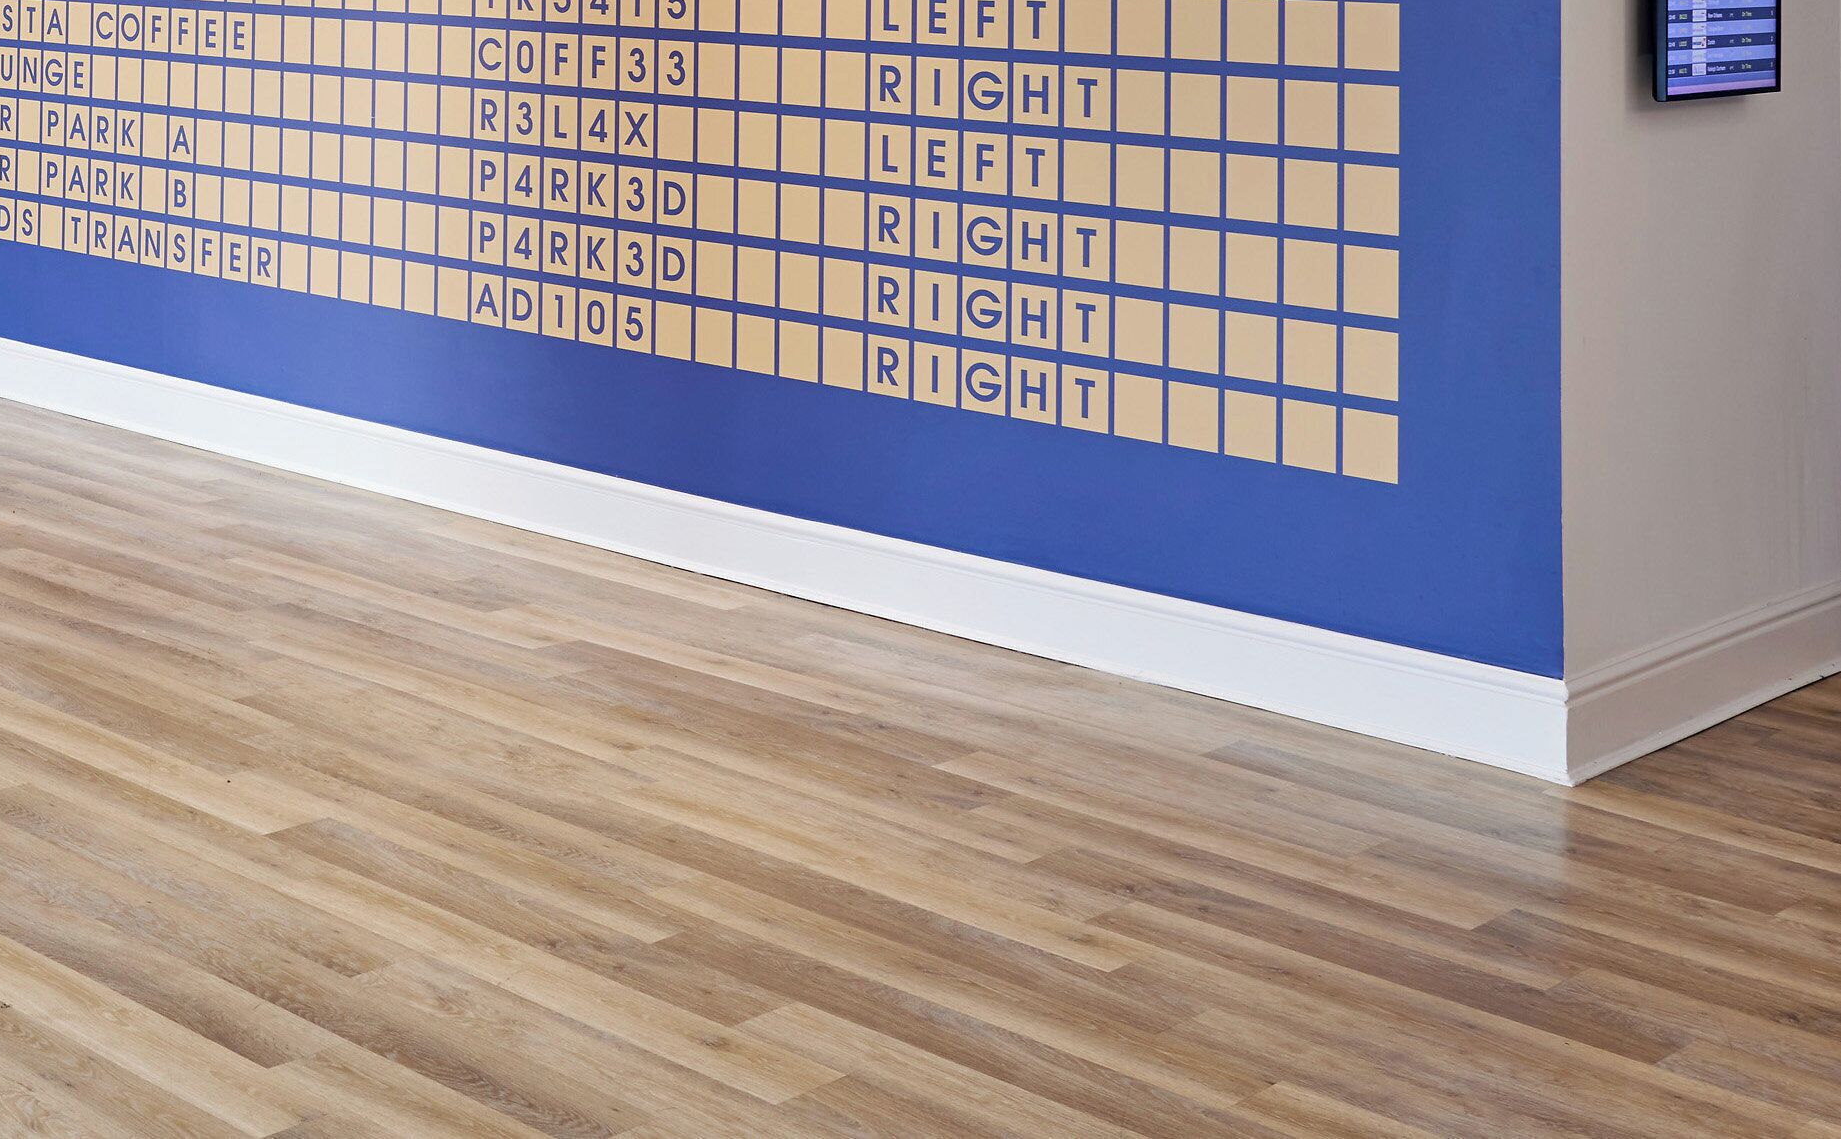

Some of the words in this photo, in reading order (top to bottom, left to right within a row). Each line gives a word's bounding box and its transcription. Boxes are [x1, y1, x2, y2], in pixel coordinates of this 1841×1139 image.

[96, 13, 244, 50] COFFEE
[880, 66, 1097, 117] RIGHT
[48, 111, 134, 147] PARK
[172, 125, 190, 154] A
[482, 99, 646, 145] R3L4X
[47, 162, 133, 199] PARK
[173, 178, 188, 209] B
[481, 161, 685, 215] P4RK3D
[883, 136, 1045, 186] LEFT
[72, 217, 271, 276] TRANSFER
[480, 221, 684, 281] P4RK3D
[879, 205, 1096, 267] RIGHT
[477, 285, 643, 341] AD105
[878, 276, 1096, 342] RIGHT
[878, 347, 1095, 418] RIGHT
